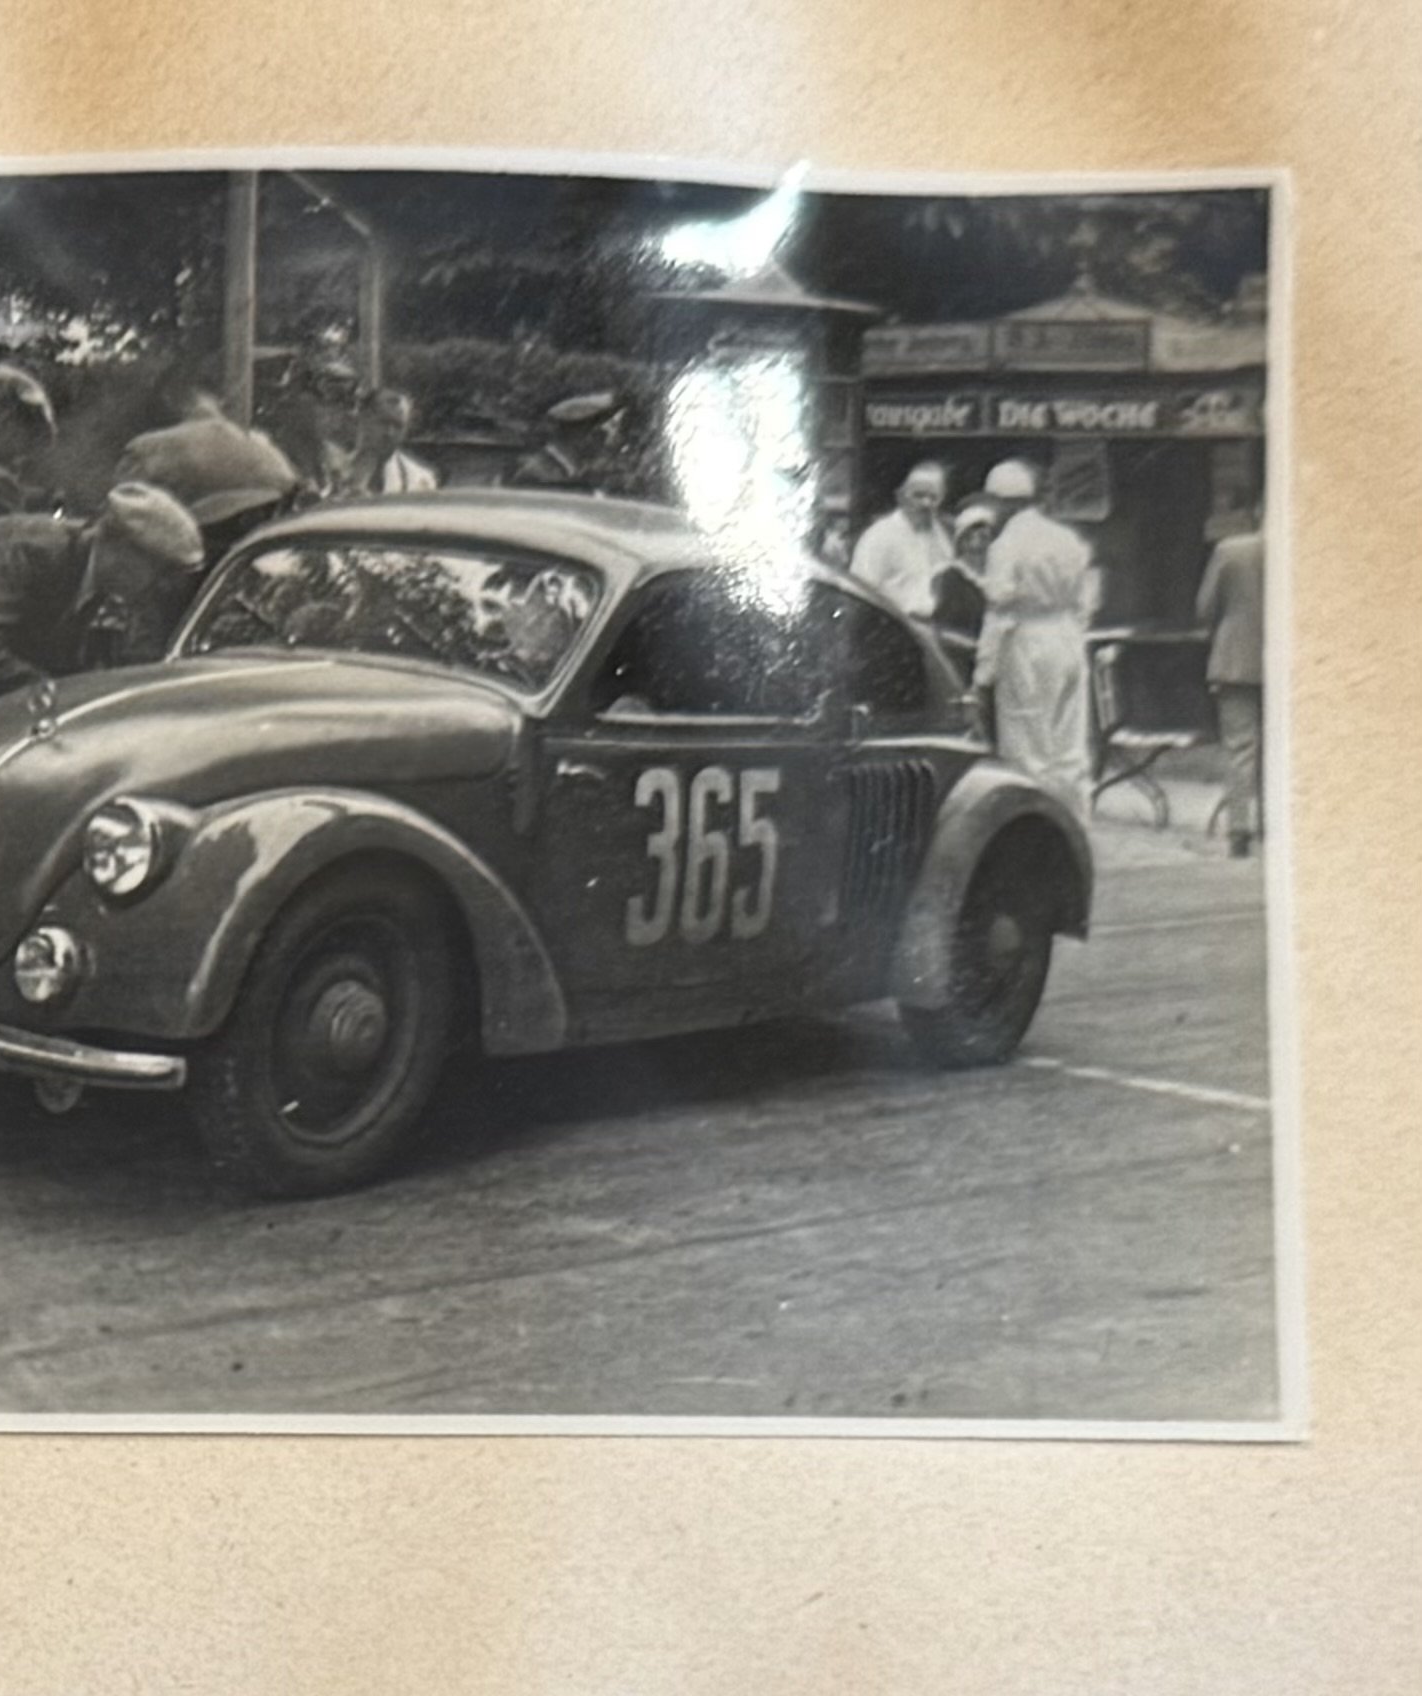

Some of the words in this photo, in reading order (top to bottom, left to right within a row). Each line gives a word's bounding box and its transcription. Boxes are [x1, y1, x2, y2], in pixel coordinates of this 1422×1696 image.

[998, 401, 1048, 430] DIE
[1054, 400, 1159, 429] WOCHE
[625, 766, 781, 946] 365
